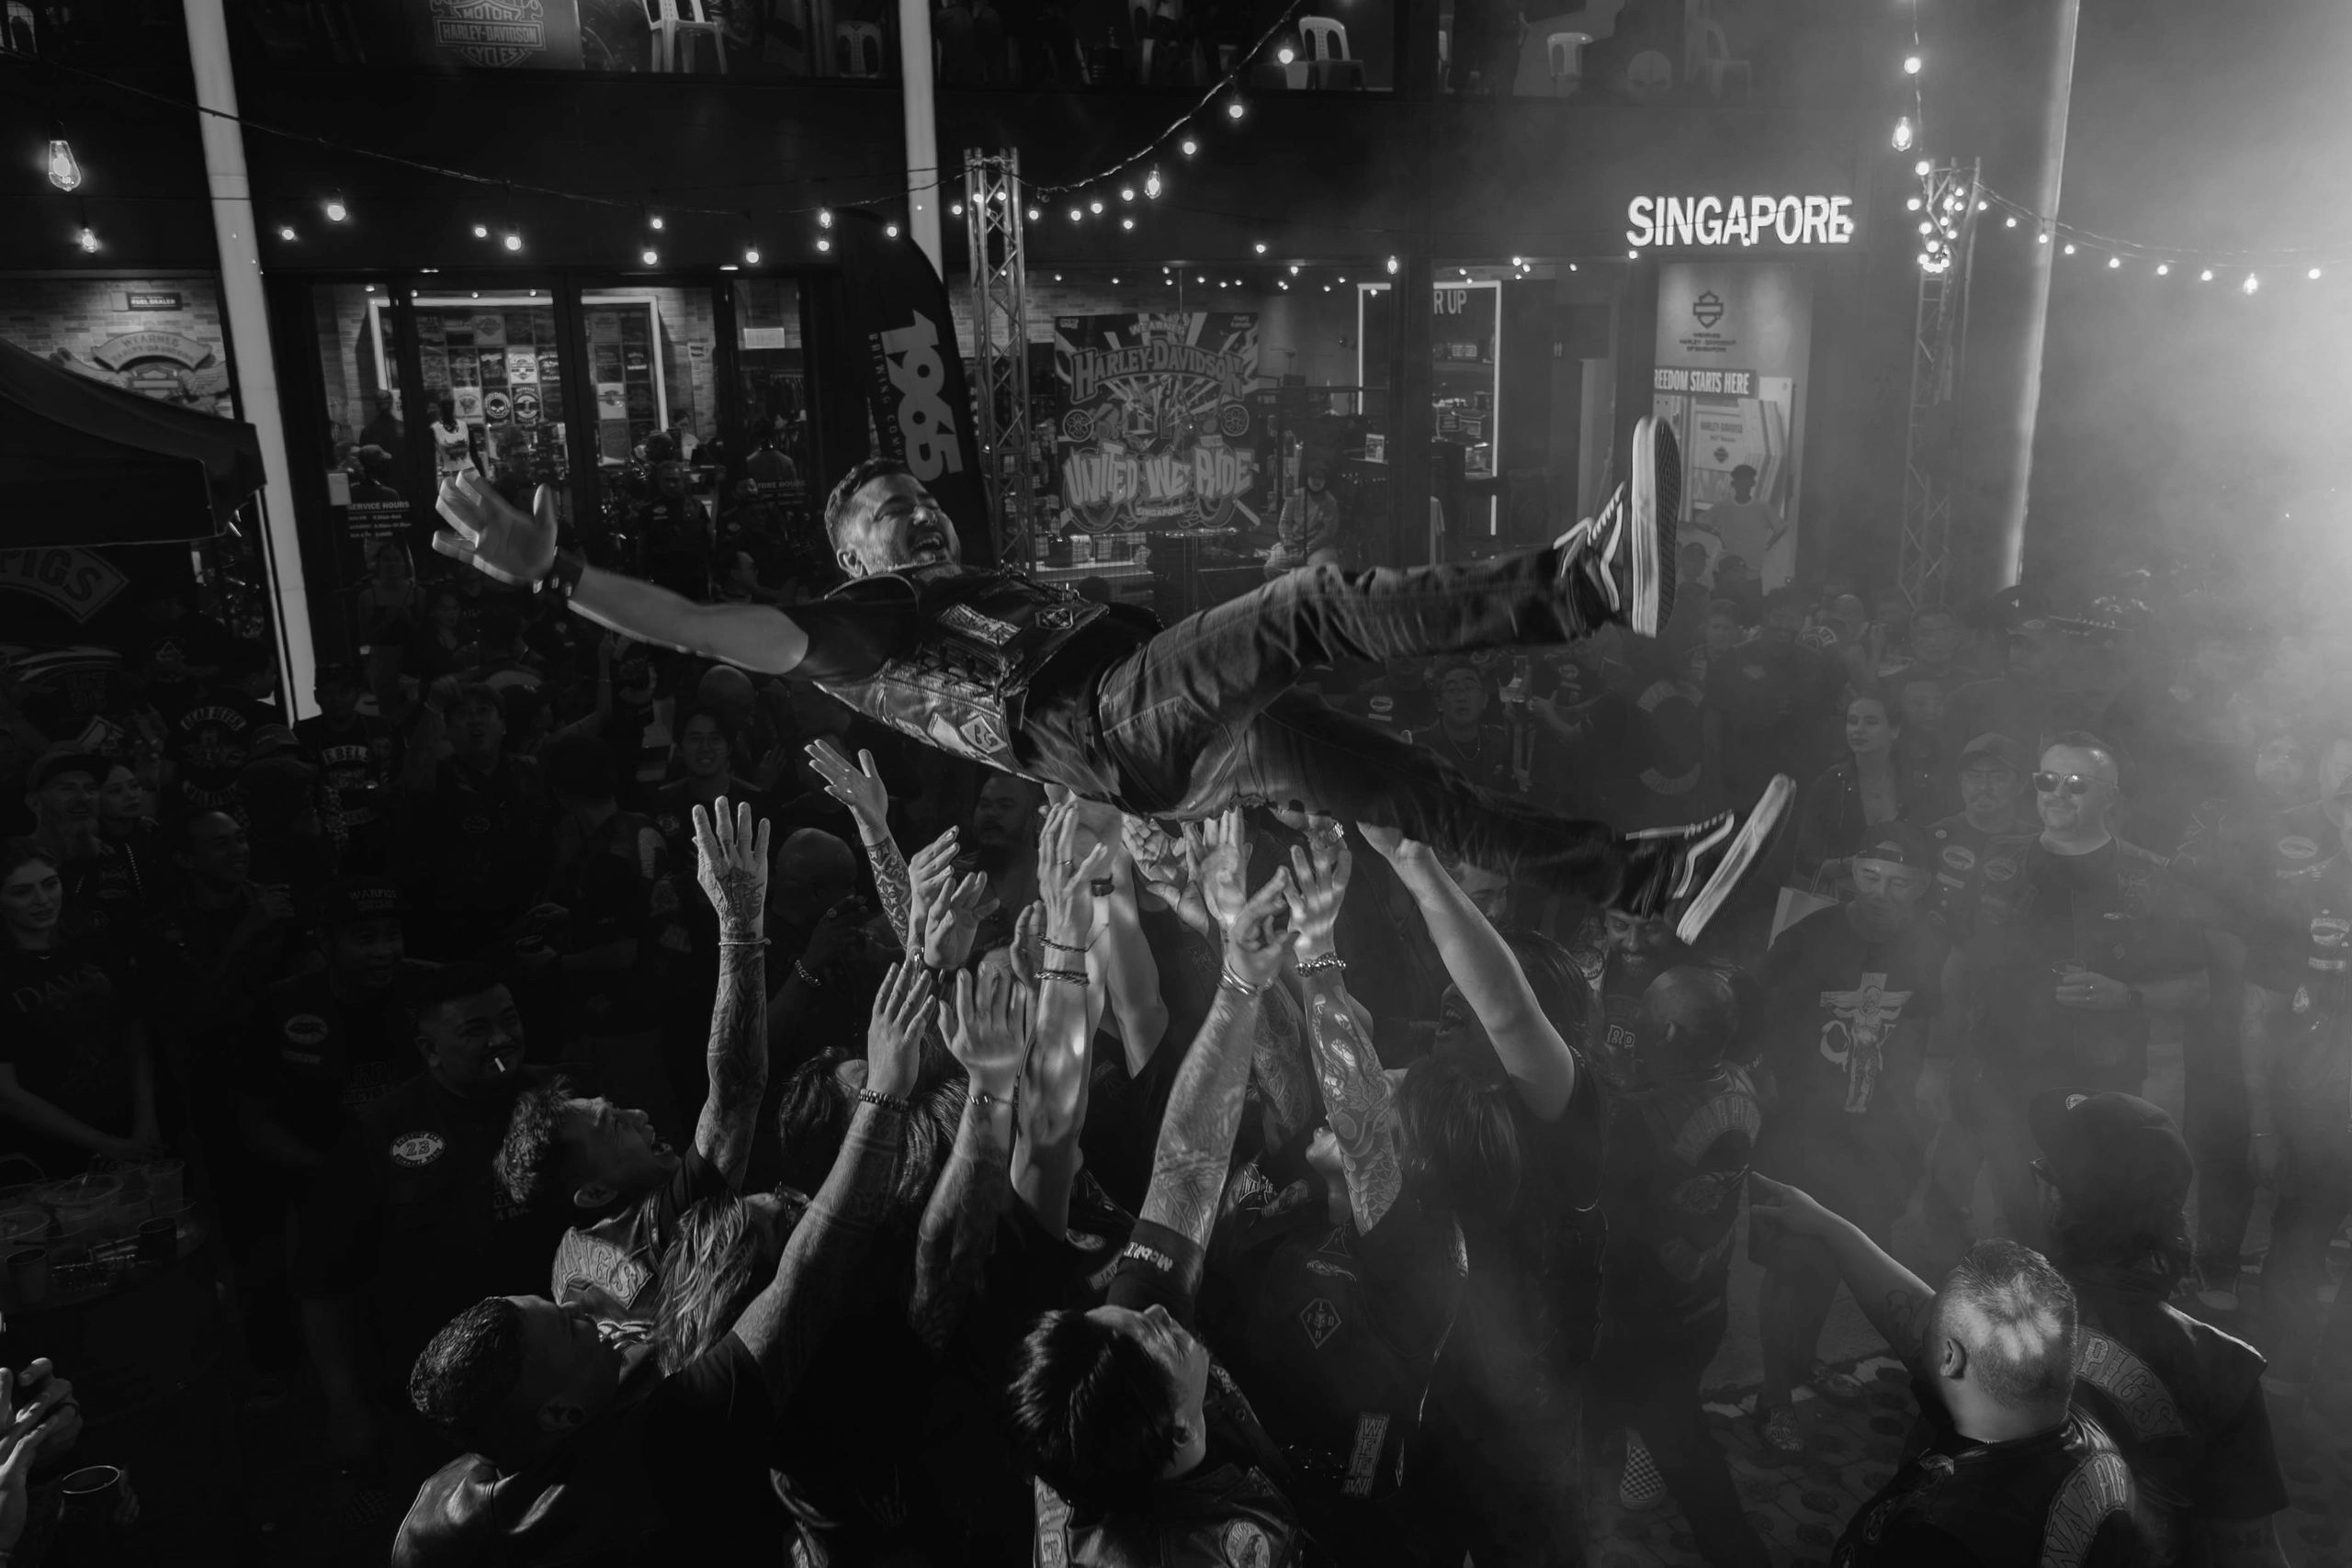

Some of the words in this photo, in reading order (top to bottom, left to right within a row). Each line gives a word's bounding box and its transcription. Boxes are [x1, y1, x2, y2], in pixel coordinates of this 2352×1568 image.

[442, 23, 538, 43] HARLEY-DAVIDSON
[1626, 196, 1852, 246] SINGAPORE
[1447, 289, 1467, 315] UP
[1071, 337, 1244, 402] HARLEY-DAVIDSON
[1690, 370, 1723, 393] STARTS
[1723, 372, 1750, 395] HERE
[880, 309, 964, 481] 1965
[1063, 442, 1138, 505] UNITED
[1146, 456, 1192, 499] WE
[1194, 447, 1254, 498] RIDE
[405, 1139, 430, 1156] 23
